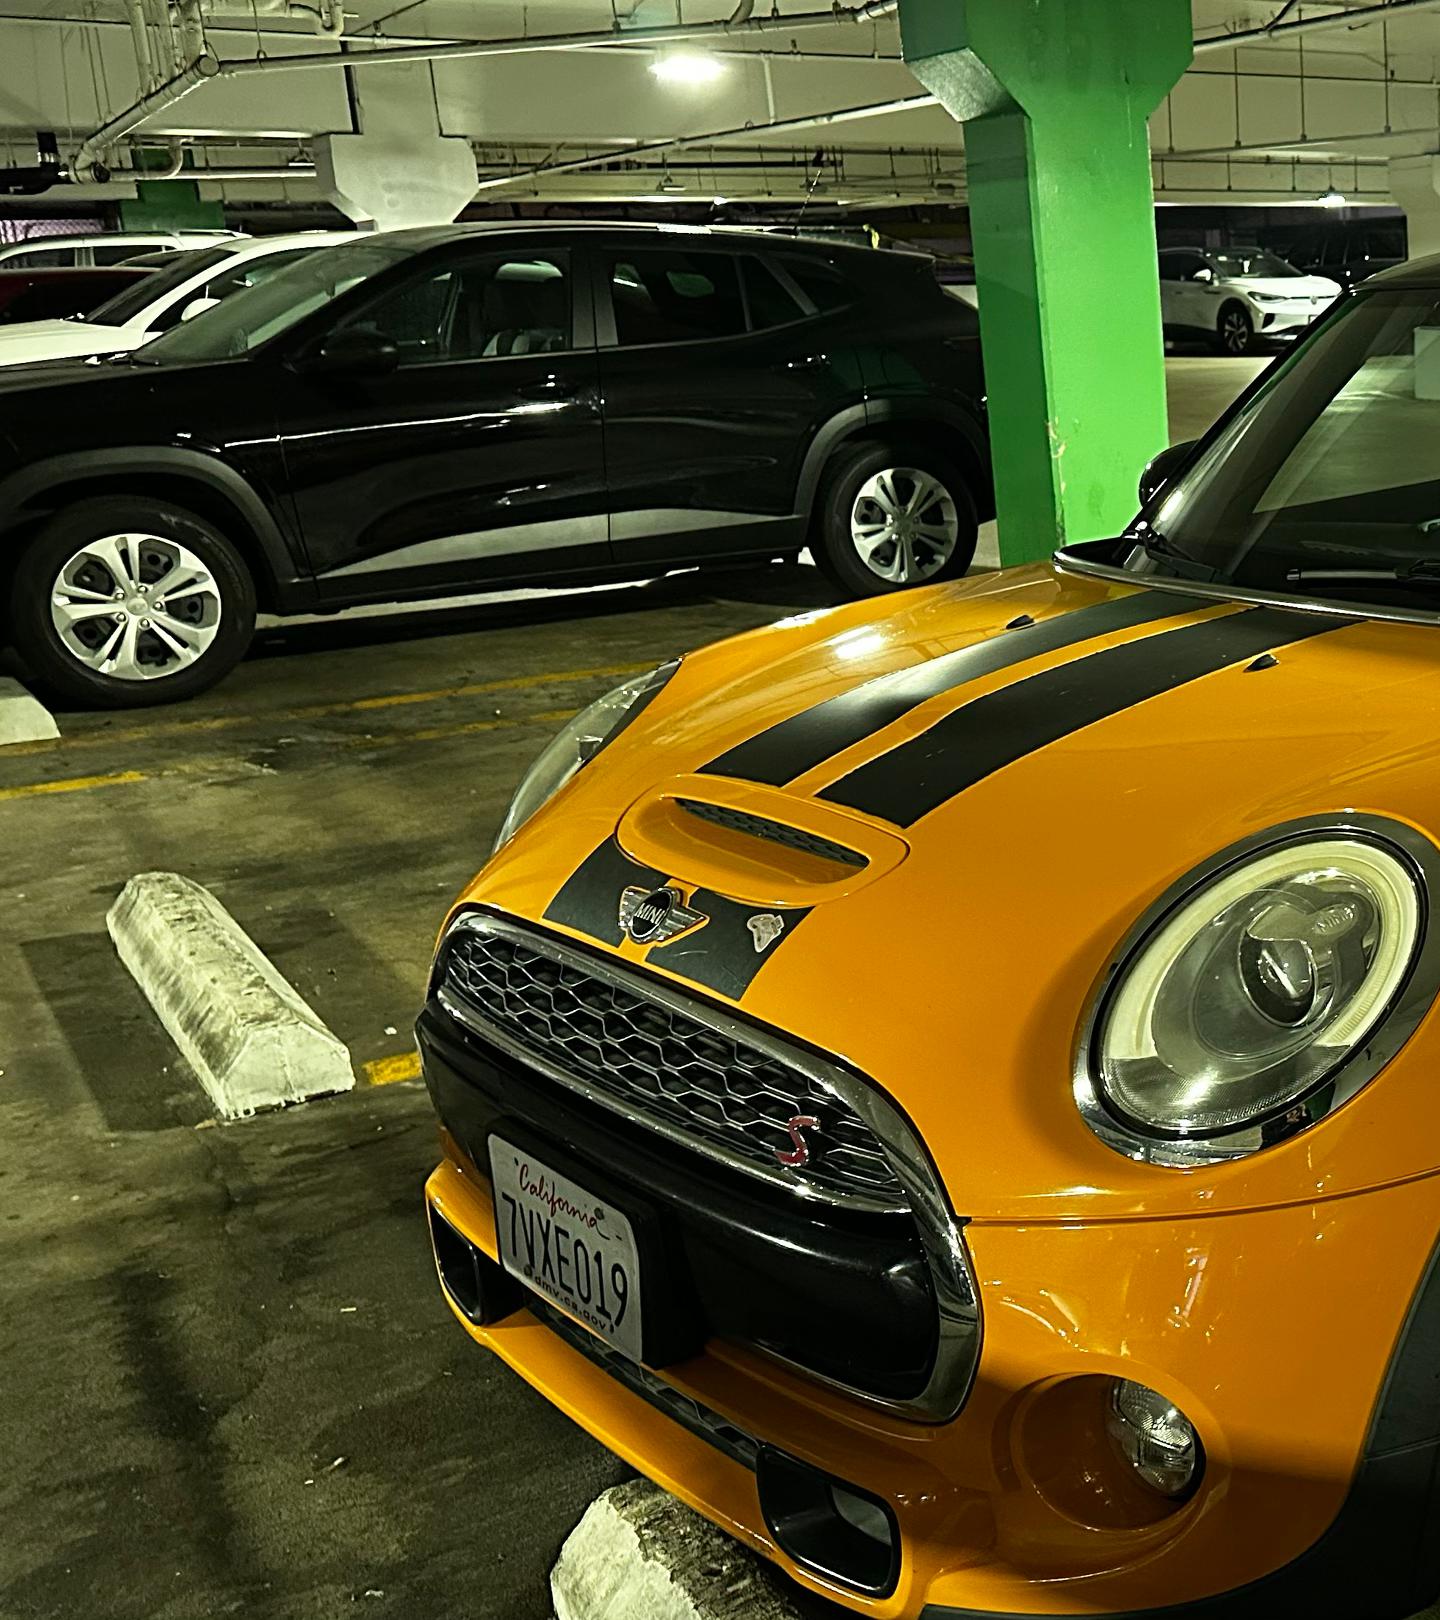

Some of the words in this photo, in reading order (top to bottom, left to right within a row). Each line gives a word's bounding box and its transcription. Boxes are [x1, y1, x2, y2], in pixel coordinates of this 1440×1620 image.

[634, 903, 666, 925] MINI
[519, 1163, 611, 1241] California
[501, 1191, 628, 1327] 7VXE019
[534, 1276, 607, 1330] dmv.ca.gov
